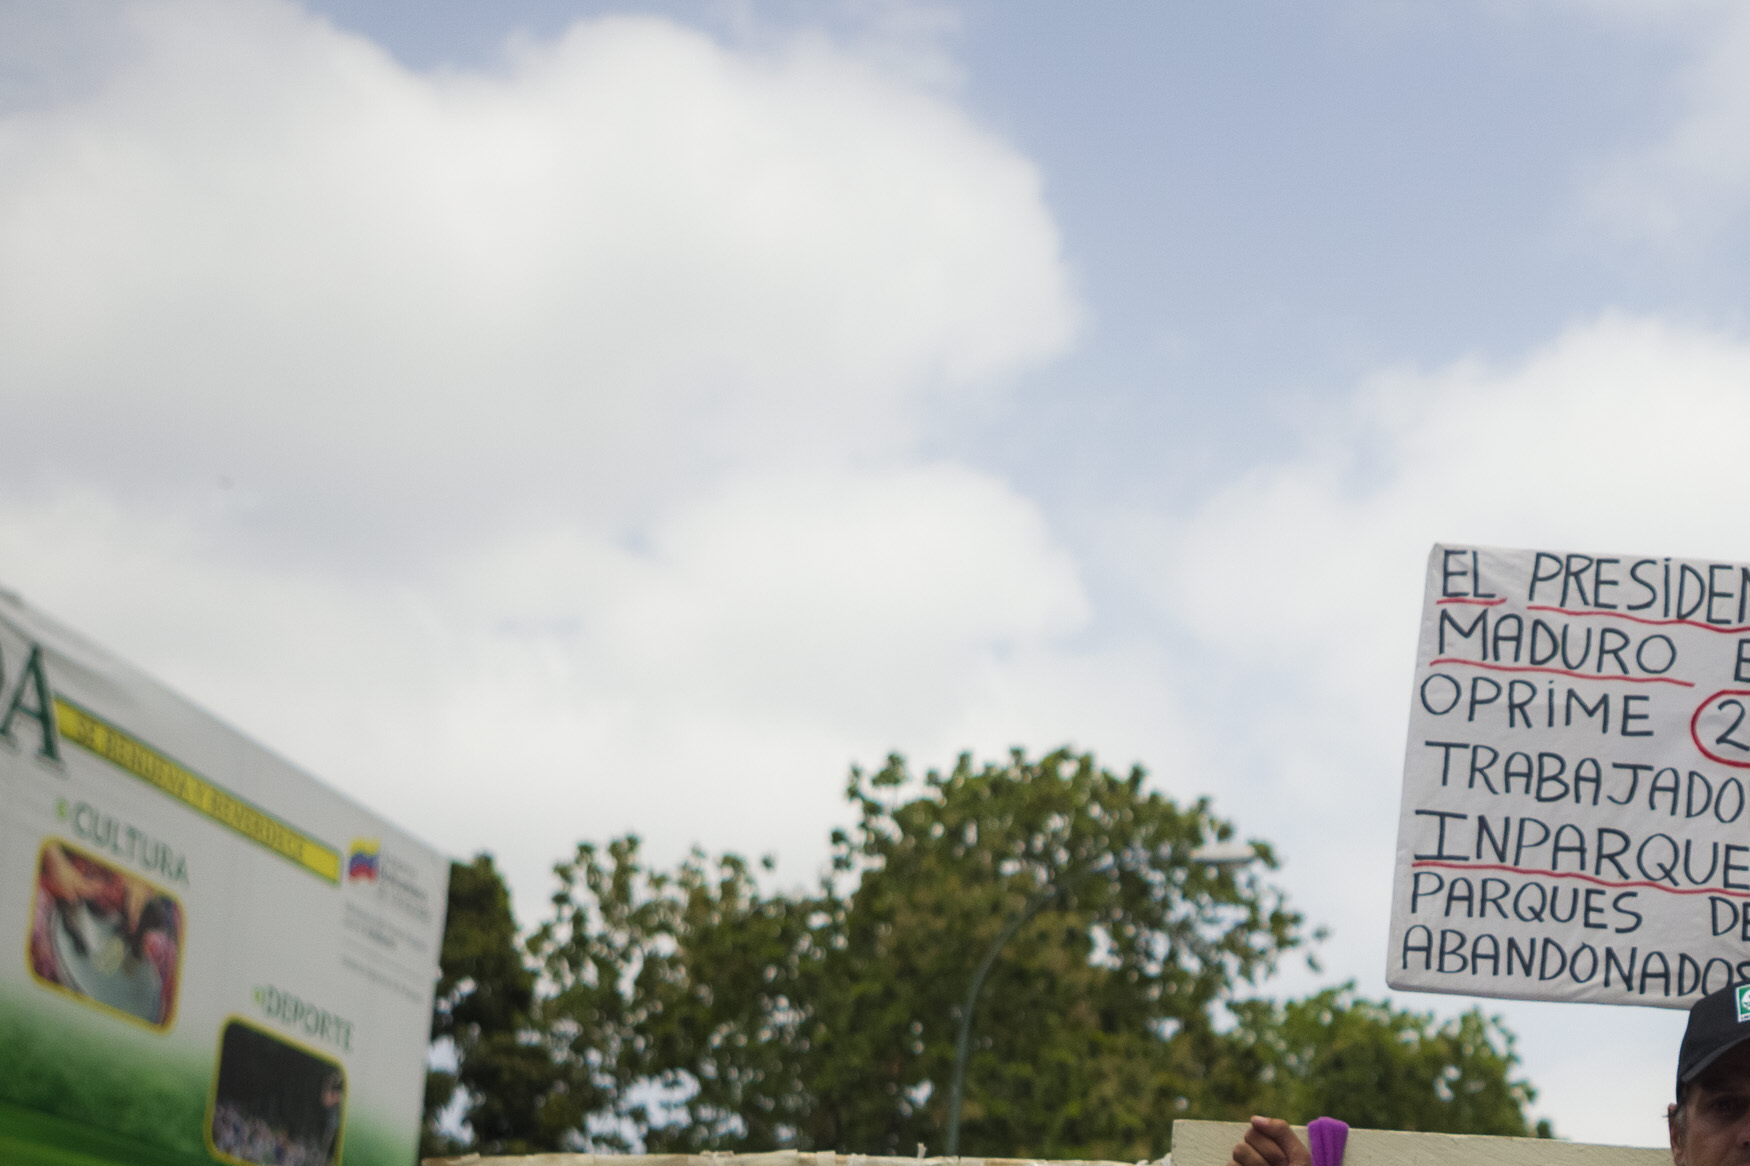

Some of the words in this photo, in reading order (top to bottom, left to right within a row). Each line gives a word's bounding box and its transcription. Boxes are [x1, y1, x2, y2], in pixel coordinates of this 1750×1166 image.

[1442, 550, 1488, 599] EL
[1439, 610, 1676, 675] MADURO
[1420, 673, 1653, 736] OPRIME
[73, 803, 190, 885] CULTURA
[1411, 872, 1642, 933] PARQUES
[264, 985, 355, 1053] DEPORTE
